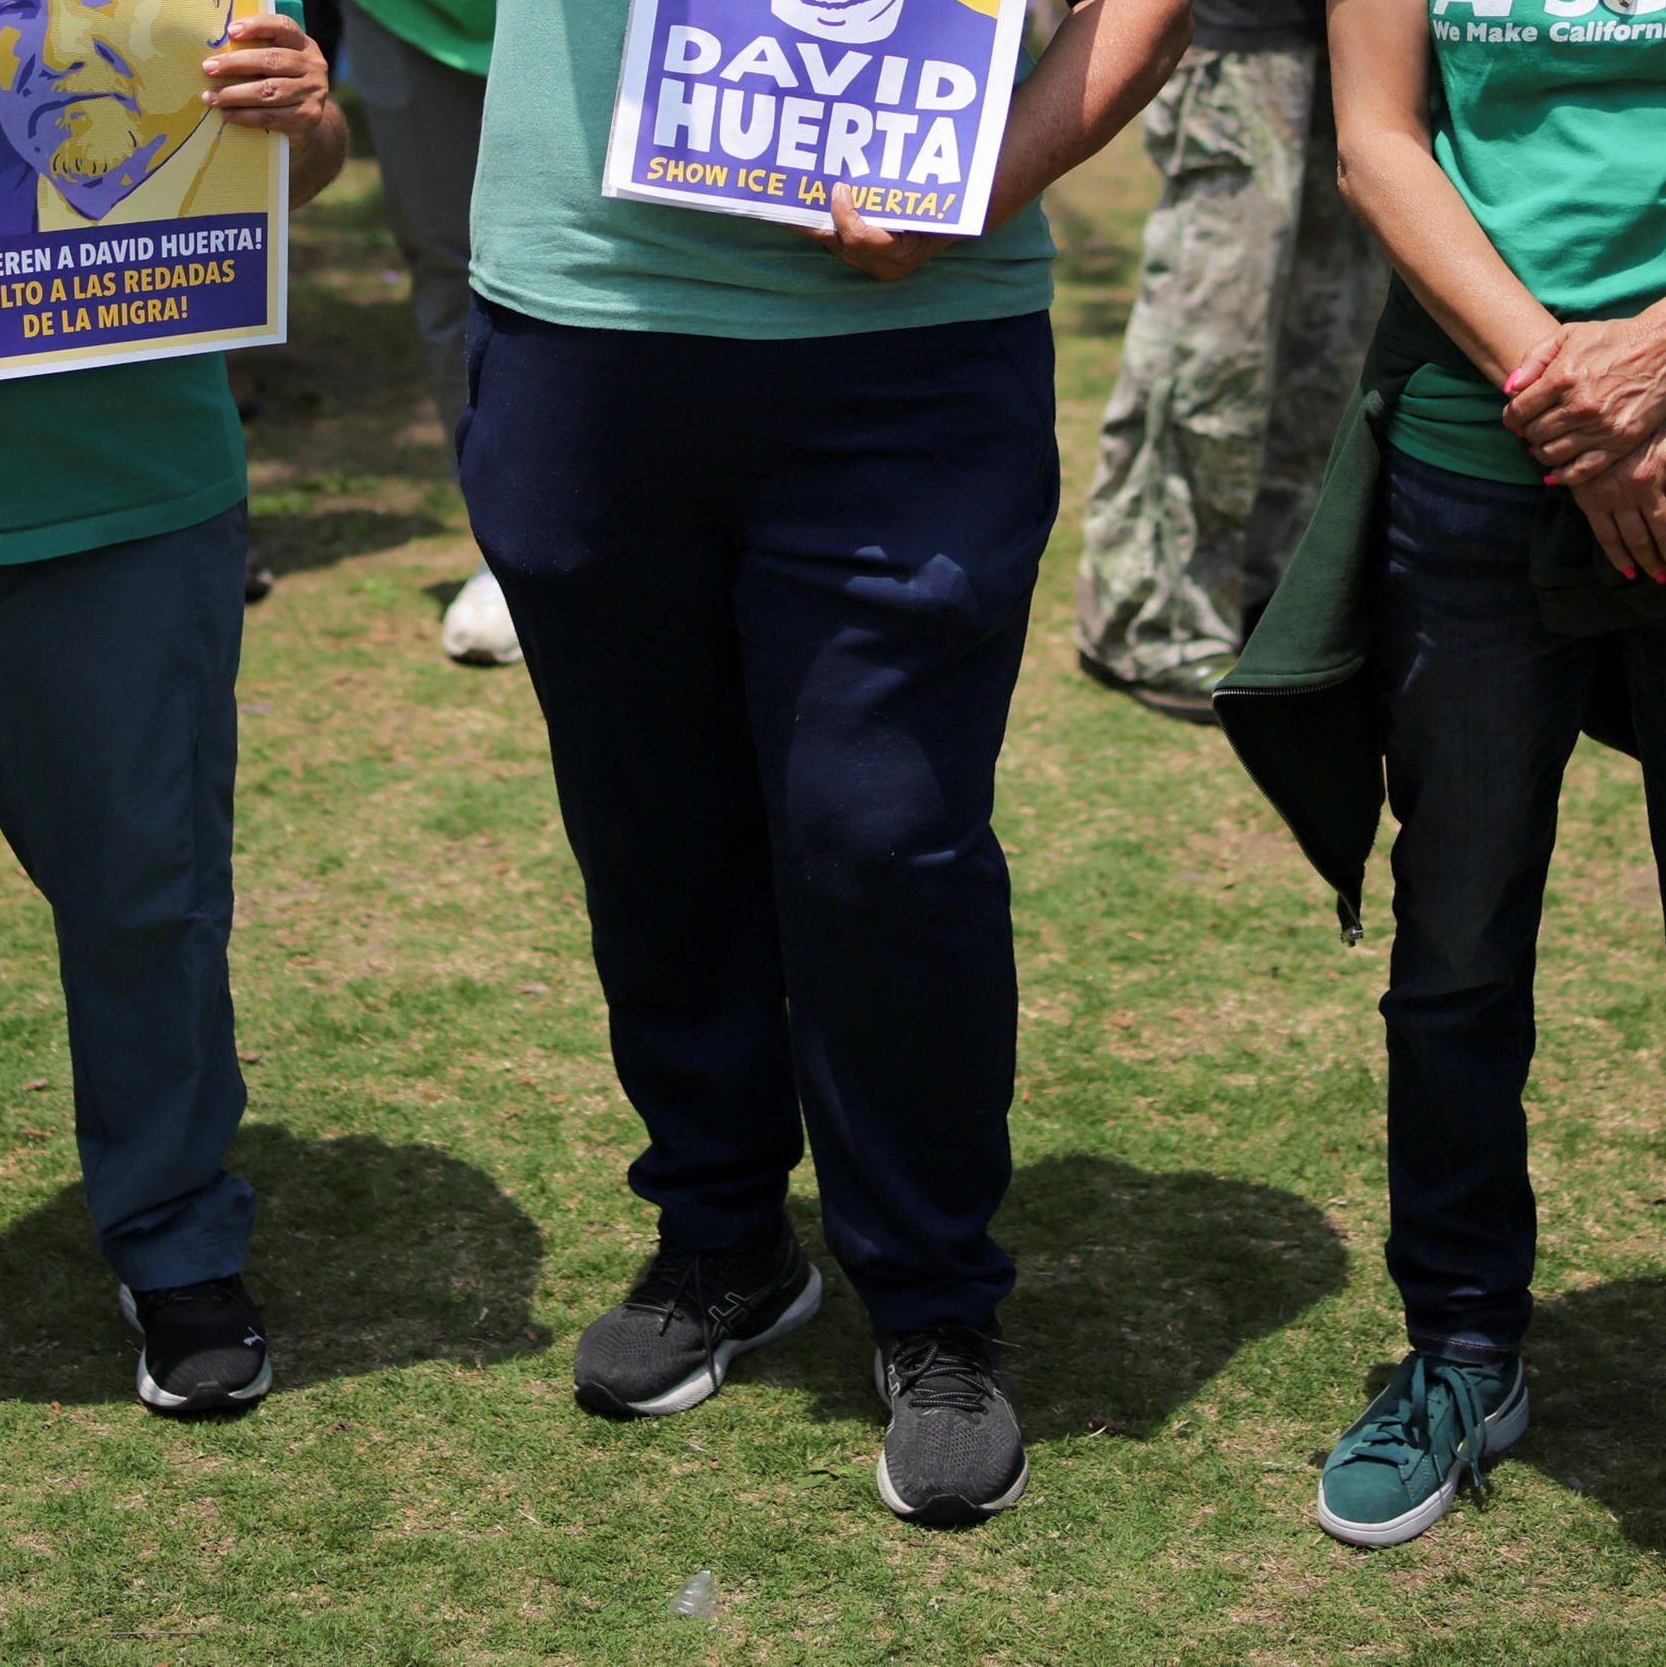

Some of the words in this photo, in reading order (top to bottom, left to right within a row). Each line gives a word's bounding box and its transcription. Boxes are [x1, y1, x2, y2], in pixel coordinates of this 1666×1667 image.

[1432, 19, 1461, 42] We
[1466, 20, 1538, 44] Make
[663, 24, 977, 111] DAVID
[653, 77, 962, 185] HUERTA
[646, 156, 729, 188] SHOW
[737, 167, 787, 196] ICE
[798, 175, 827, 206] LA
[847, 183, 957, 220] UERTA!
[57, 248, 75, 269] A
[80, 235, 154, 268] DAVID
[160, 227, 263, 259] HUERTA!
[50, 278, 68, 303] A
[73, 271, 117, 300] LAS
[124, 259, 236, 294] REDADAS
[23, 311, 55, 339] DE
[61, 307, 93, 334] LA
[98, 295, 189, 329] MIGRA!
